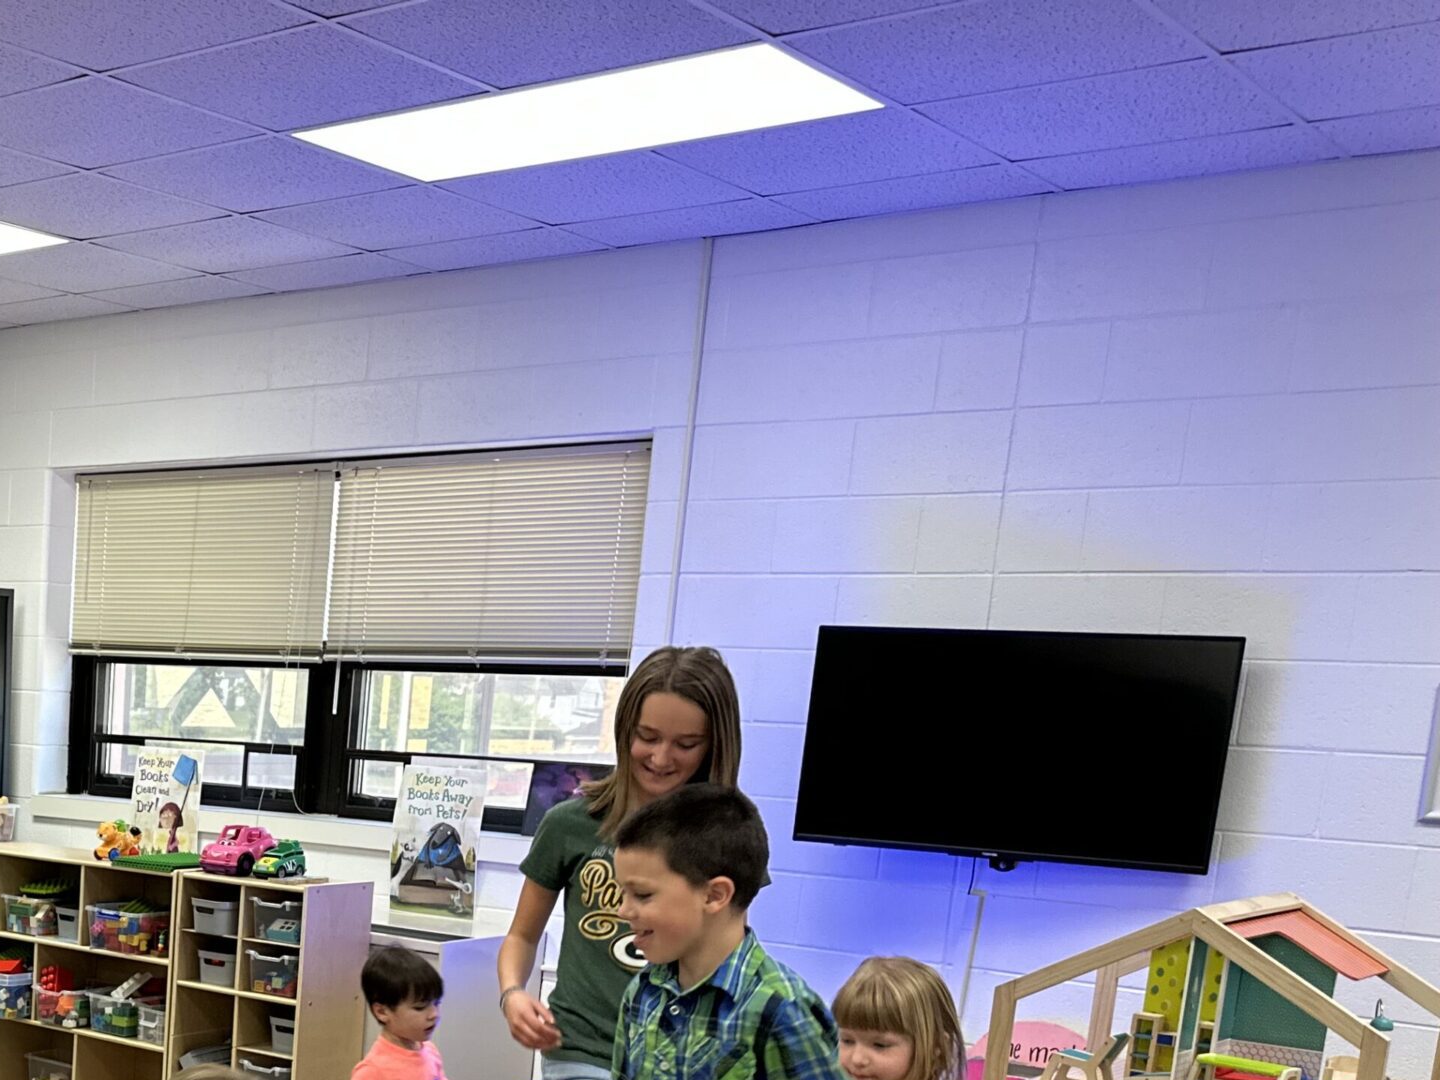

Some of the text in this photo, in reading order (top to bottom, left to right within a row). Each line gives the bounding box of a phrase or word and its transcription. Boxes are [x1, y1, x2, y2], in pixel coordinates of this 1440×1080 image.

[138, 756, 175, 769] Keep Your
[140, 769, 169, 783] Books
[415, 772, 469, 788] Keep Your
[135, 785, 170, 797] Clean and
[407, 787, 474, 808] Books Away
[136, 797, 160, 814] Dry!
[436, 804, 468, 821] Pets!
